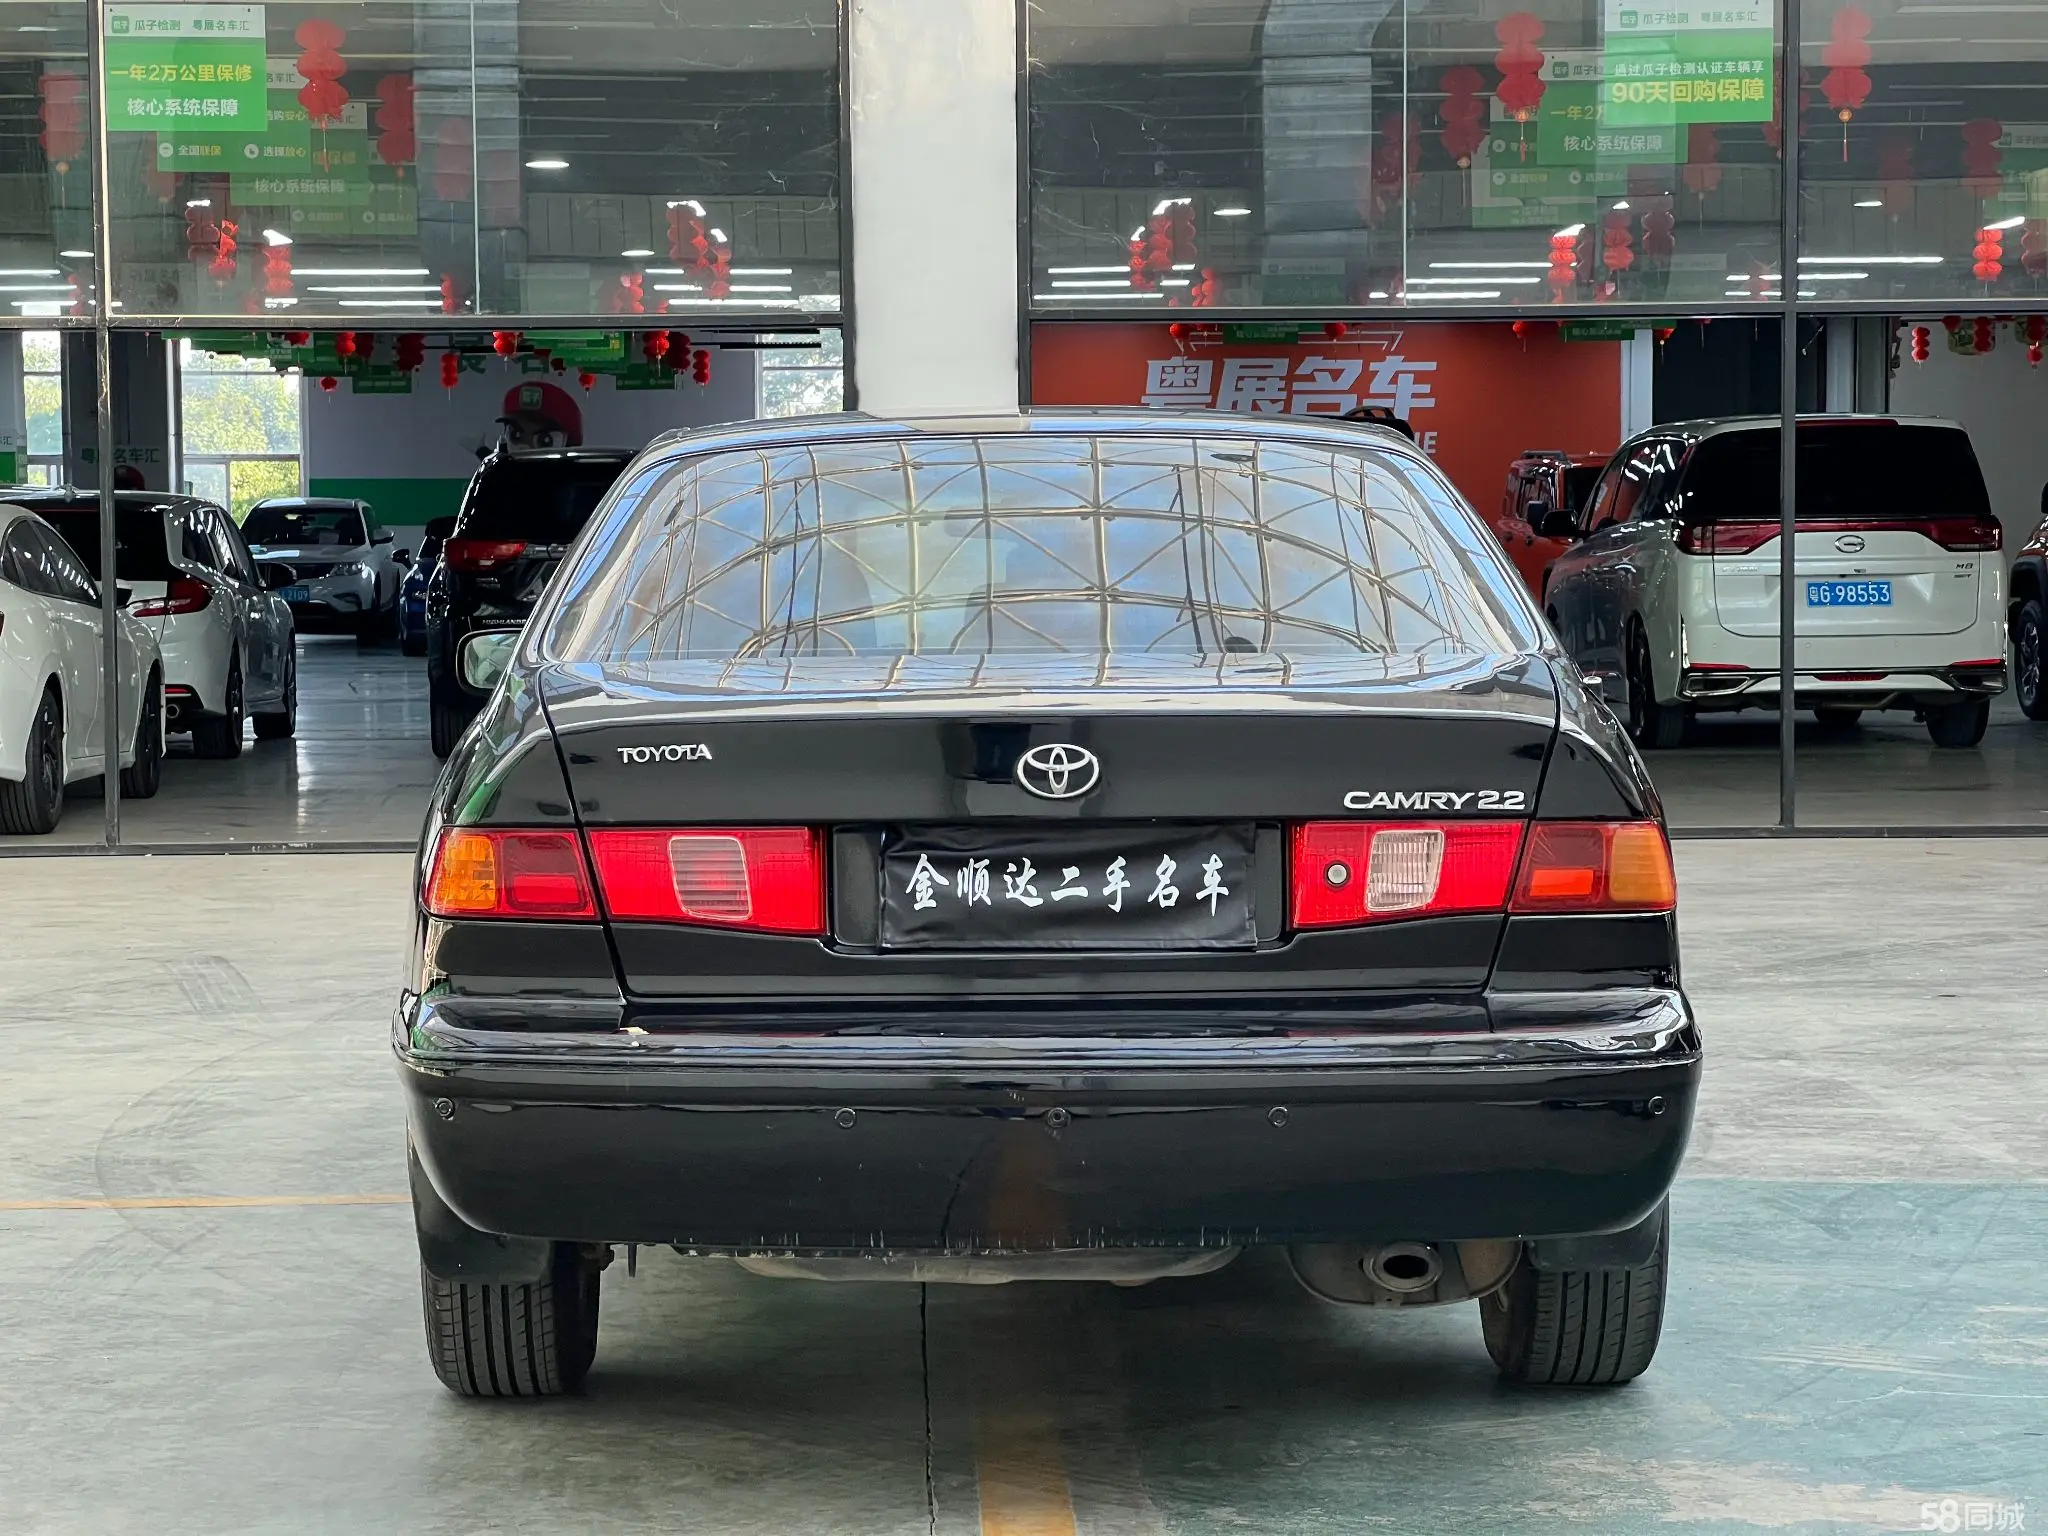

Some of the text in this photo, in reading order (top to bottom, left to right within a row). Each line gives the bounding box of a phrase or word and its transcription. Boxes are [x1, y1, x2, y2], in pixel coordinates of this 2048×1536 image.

[134, 20, 181, 31] 瓜子检测
[110, 64, 253, 82] 一年2万公里保修
[1615, 60, 1765, 77] 通过瓜子检测认证车辆享
[1612, 78, 1765, 104] 90天回购保障
[127, 98, 239, 117] 核心系统保障
[1563, 135, 1663, 152] 核心系统保障
[1141, 356, 1438, 420] 粤展名车
[617, 743, 713, 764] TOYOTA
[1343, 791, 1475, 810] CAMRY
[905, 853, 1230, 917] 金顺达二手名车
